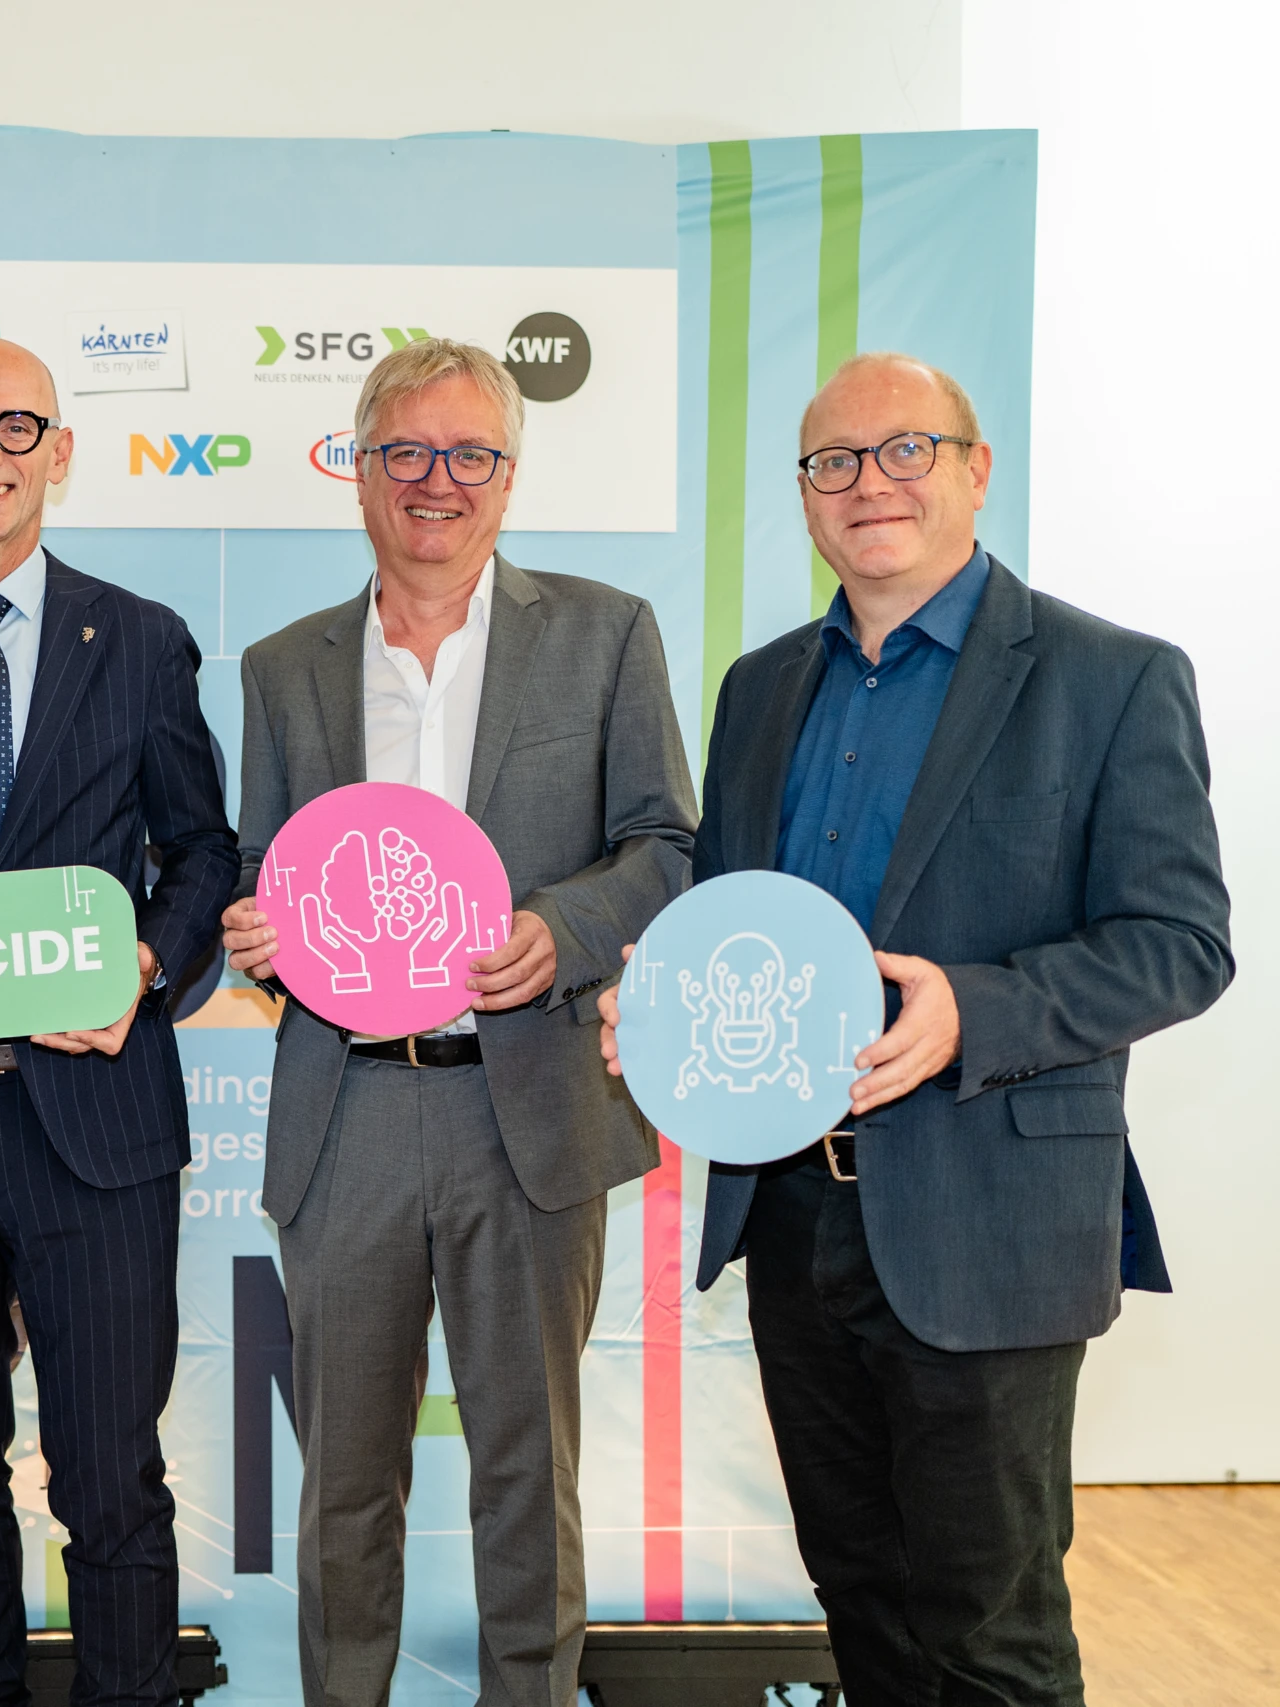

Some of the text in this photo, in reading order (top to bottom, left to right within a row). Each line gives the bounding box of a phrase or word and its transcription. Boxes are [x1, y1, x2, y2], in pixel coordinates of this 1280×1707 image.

[294, 332, 373, 361] SFG
[499, 336, 571, 363] KWF
[113, 361, 134, 375] my
[254, 374, 287, 383] NEUES
[290, 374, 334, 383] DENKEN.
[130, 434, 251, 476] NXP
